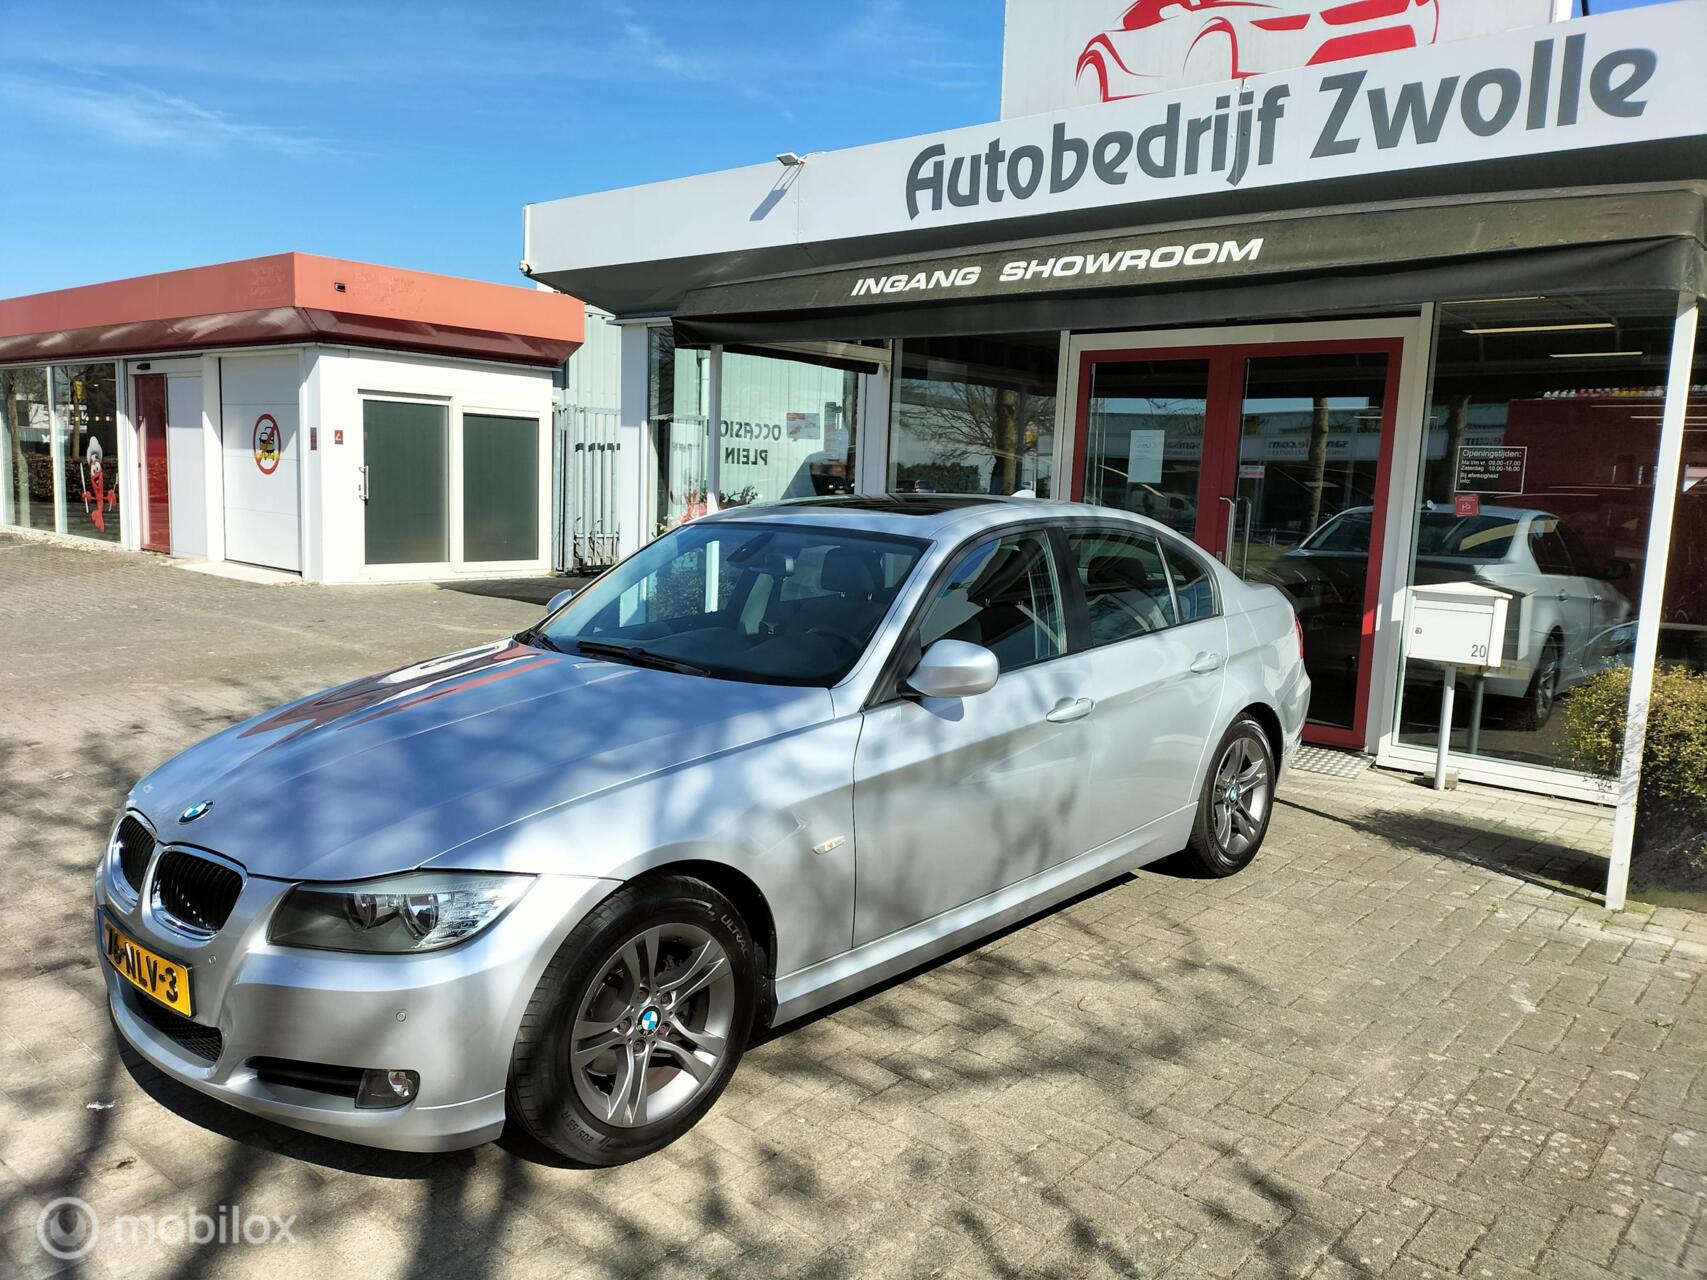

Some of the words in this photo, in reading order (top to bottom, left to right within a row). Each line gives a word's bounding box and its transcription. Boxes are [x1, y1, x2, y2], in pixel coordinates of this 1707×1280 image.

[905, 83, 1290, 220] Autobedrijf
[1310, 33, 1657, 159] Zwolle
[851, 266, 982, 296] INGANG
[999, 238, 1264, 281] SHOWROOM
[1462, 449, 1522, 459] Openingstijden:
[1471, 644, 1486, 658] 20
